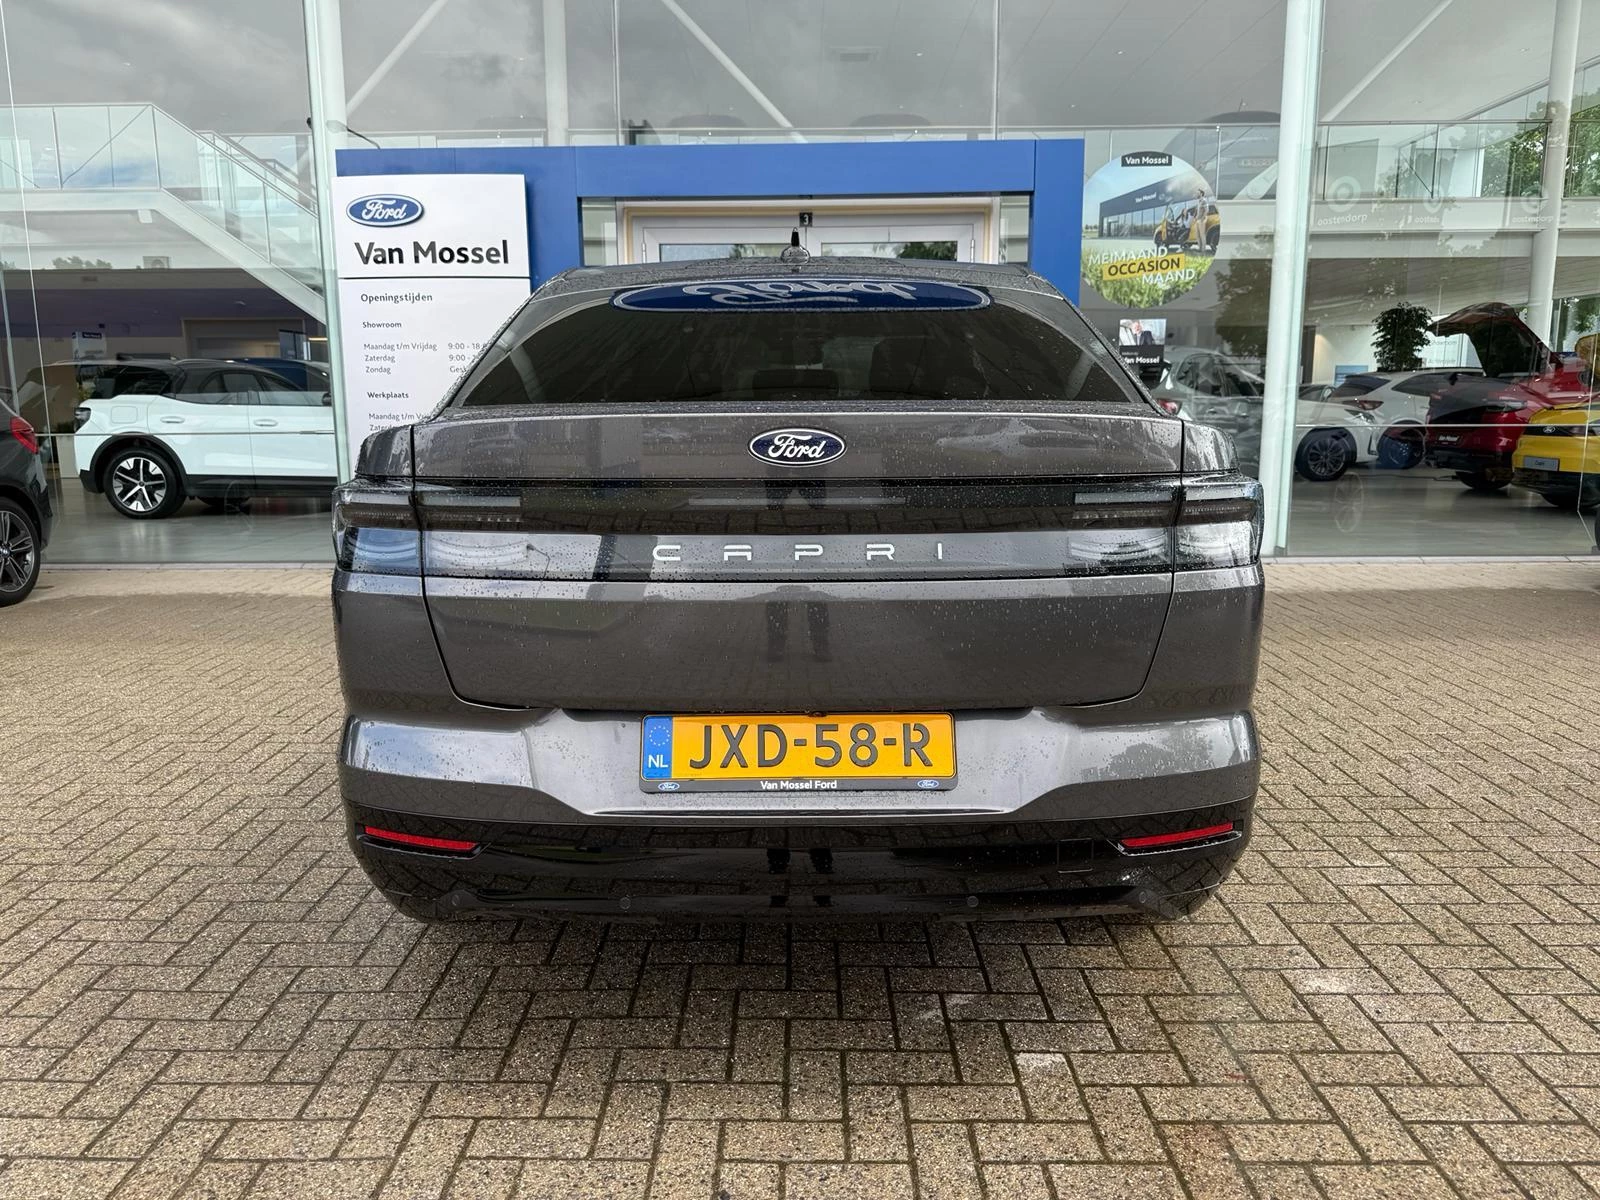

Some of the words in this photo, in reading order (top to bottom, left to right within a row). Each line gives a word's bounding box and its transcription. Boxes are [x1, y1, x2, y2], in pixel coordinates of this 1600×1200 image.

[1125, 157, 1141, 165] Van
[1142, 156, 1169, 165] Mossel
[361, 199, 407, 220] Ford
[803, 213, 809, 225] 3
[354, 242, 404, 265] Van
[413, 240, 509, 265] Mossel
[1088, 246, 1168, 266] MEIMAAND
[1108, 257, 1180, 277] OCCASION
[1142, 268, 1196, 284] MAAND
[360, 292, 433, 305] Openingstijden
[362, 321, 402, 329] Showroom
[363, 343, 396, 352] Maandag
[411, 343, 438, 352] Vrijdag
[447, 342, 465, 350] 9:00
[364, 354, 396, 363] Zaterdag
[1135, 356, 1160, 364] Mossel
[365, 366, 392, 375] Zondag
[367, 391, 409, 400] Werkplaats
[368, 412, 400, 421] Maandag
[401, 412, 415, 420] t/m
[768, 433, 827, 459] Ford
[652, 543, 943, 561] CAPRI
[648, 754, 669, 769] NL
[689, 722, 933, 769] JXD-58-R
[760, 780, 777, 790] Van
[780, 780, 812, 790] Mossel
[814, 780, 838, 789] Ford
